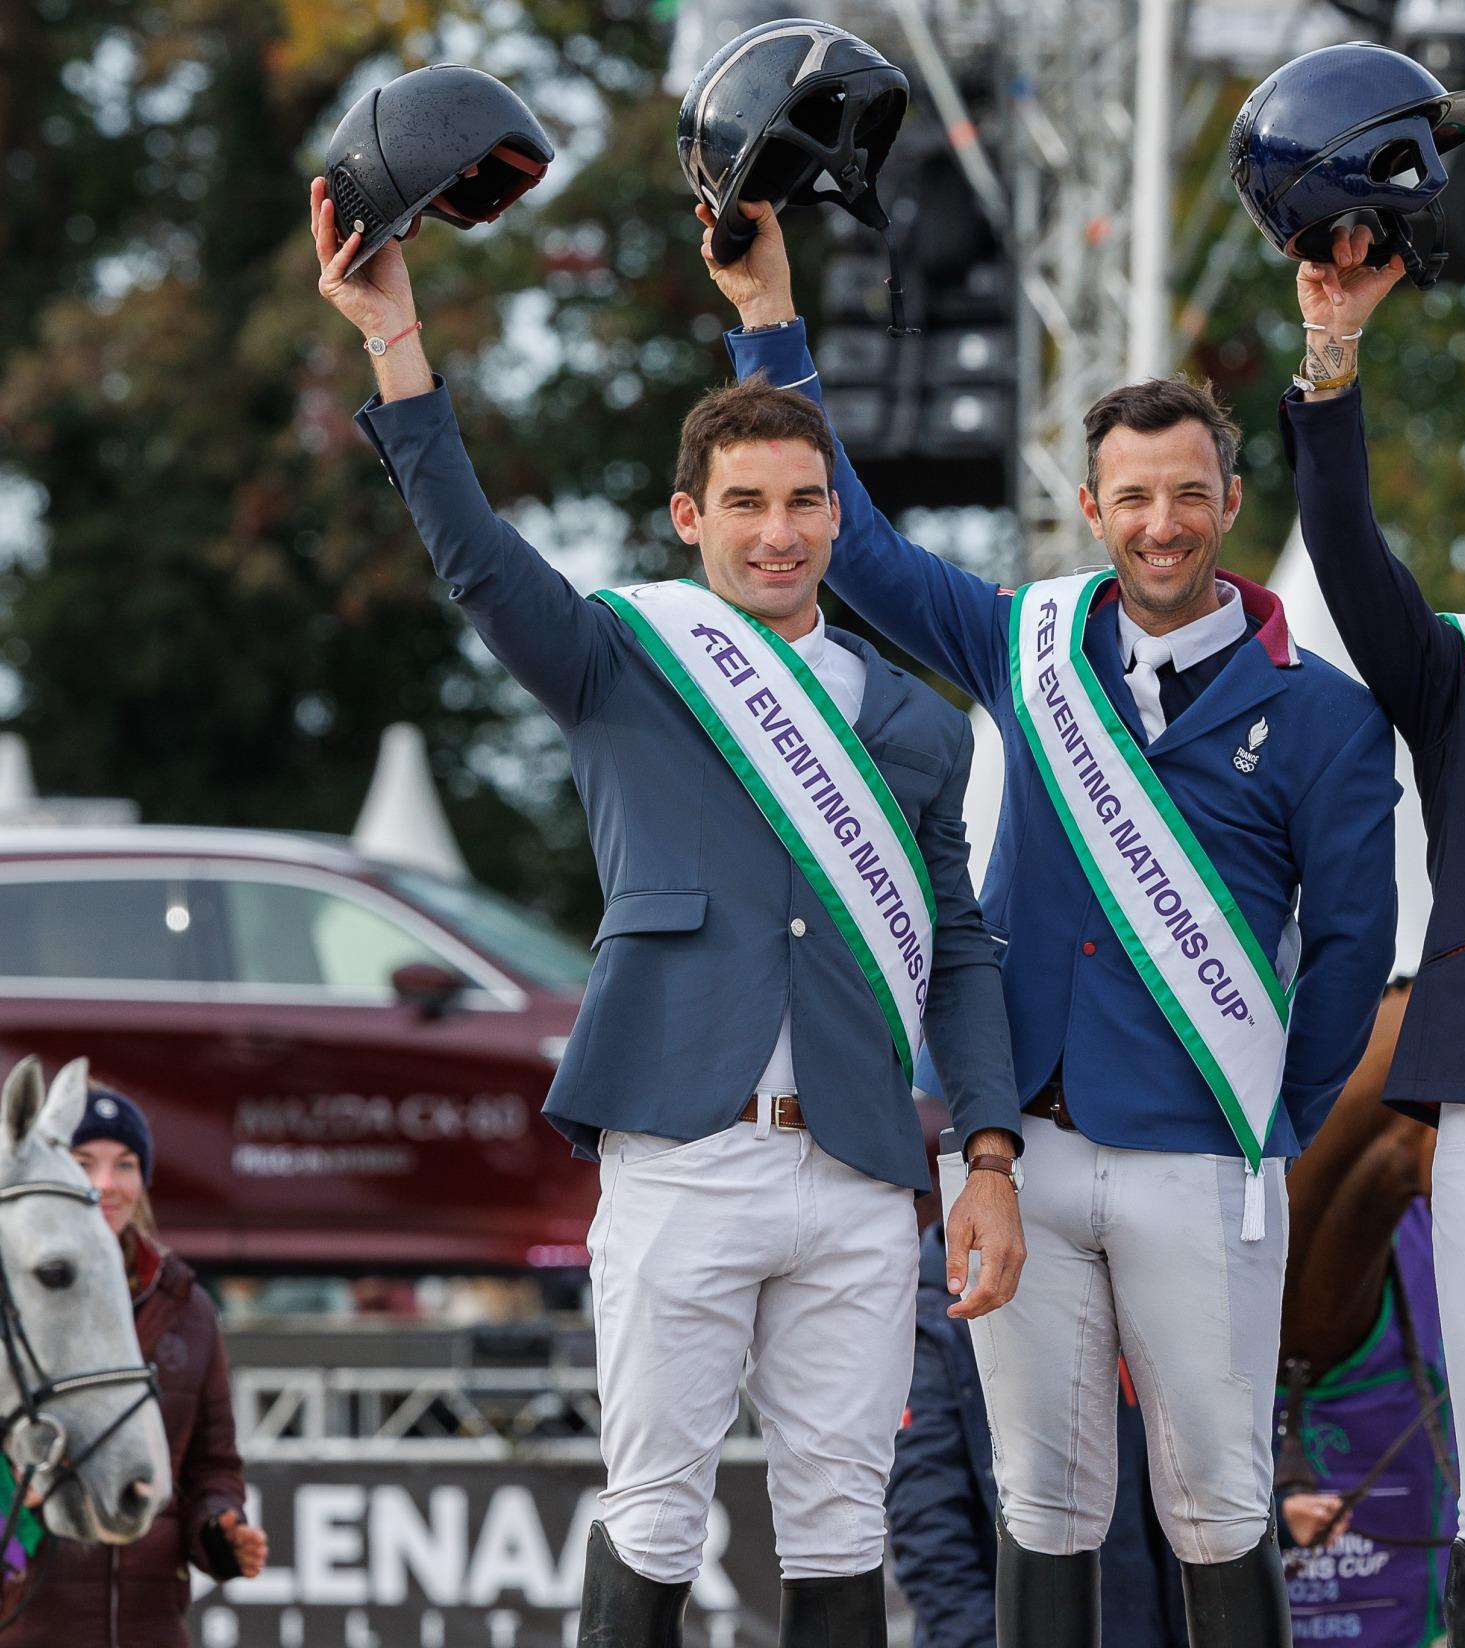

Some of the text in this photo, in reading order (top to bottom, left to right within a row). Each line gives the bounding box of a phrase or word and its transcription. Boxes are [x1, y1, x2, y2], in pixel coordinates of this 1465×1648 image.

[745, 687, 861, 847] EVENTING
[849, 841, 924, 980] NATIONS
[1038, 664, 1122, 825] EVENTING
[1109, 819, 1208, 960] NATIONS
[1288, 1579, 1339, 1602] 024
